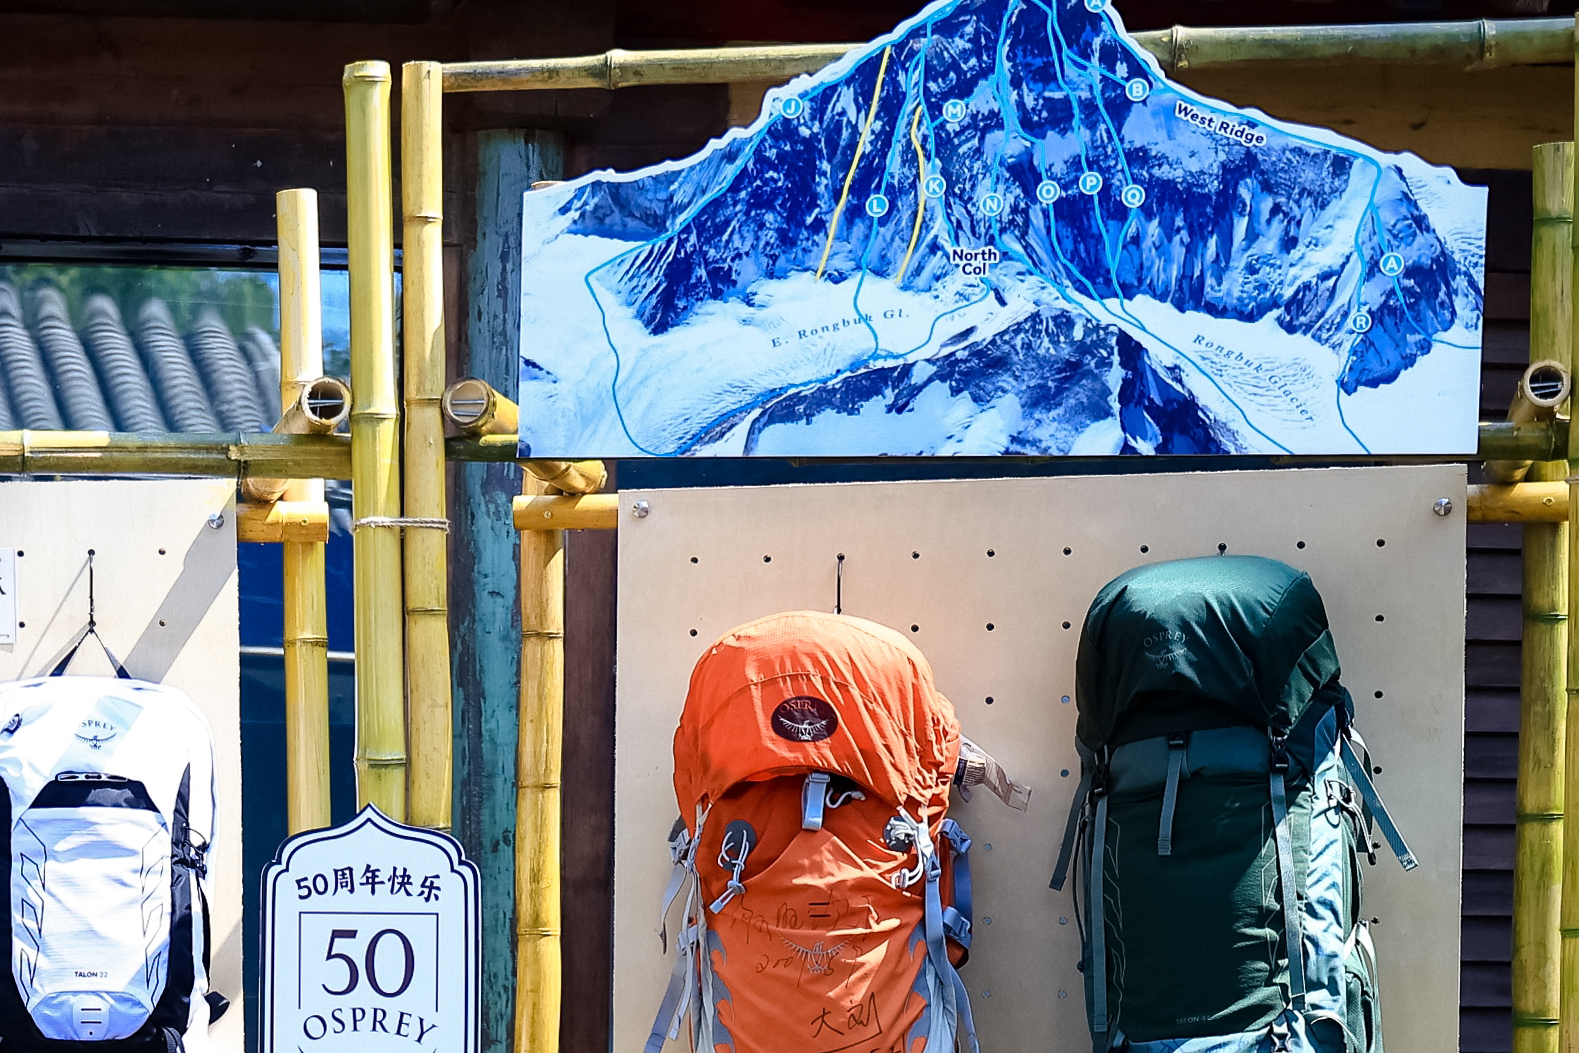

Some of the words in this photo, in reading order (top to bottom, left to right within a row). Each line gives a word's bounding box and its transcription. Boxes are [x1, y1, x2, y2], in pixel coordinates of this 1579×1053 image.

[1132, 84, 1143, 96] B
[947, 105, 961, 116] M
[1174, 100, 1216, 128] West
[1216, 118, 1266, 146] Ridge
[928, 180, 941, 192] K
[1086, 177, 1096, 189] P
[1042, 186, 1054, 198] O
[1127, 190, 1140, 203] Q
[872, 199, 882, 212] L
[986, 199, 998, 211] N
[951, 248, 997, 265] North
[961, 261, 986, 276] Col
[1386, 258, 1397, 271] A
[771, 336, 790, 349] E.
[883, 308, 910, 322] Gl.
[1356, 316, 1368, 328] R
[1143, 629, 1190, 647] OSPREY
[82, 720, 116, 731] SPREY
[295, 864, 442, 902] 50周年快乐
[321, 928, 415, 998] 50
[302, 1007, 438, 1046] OSPREY
